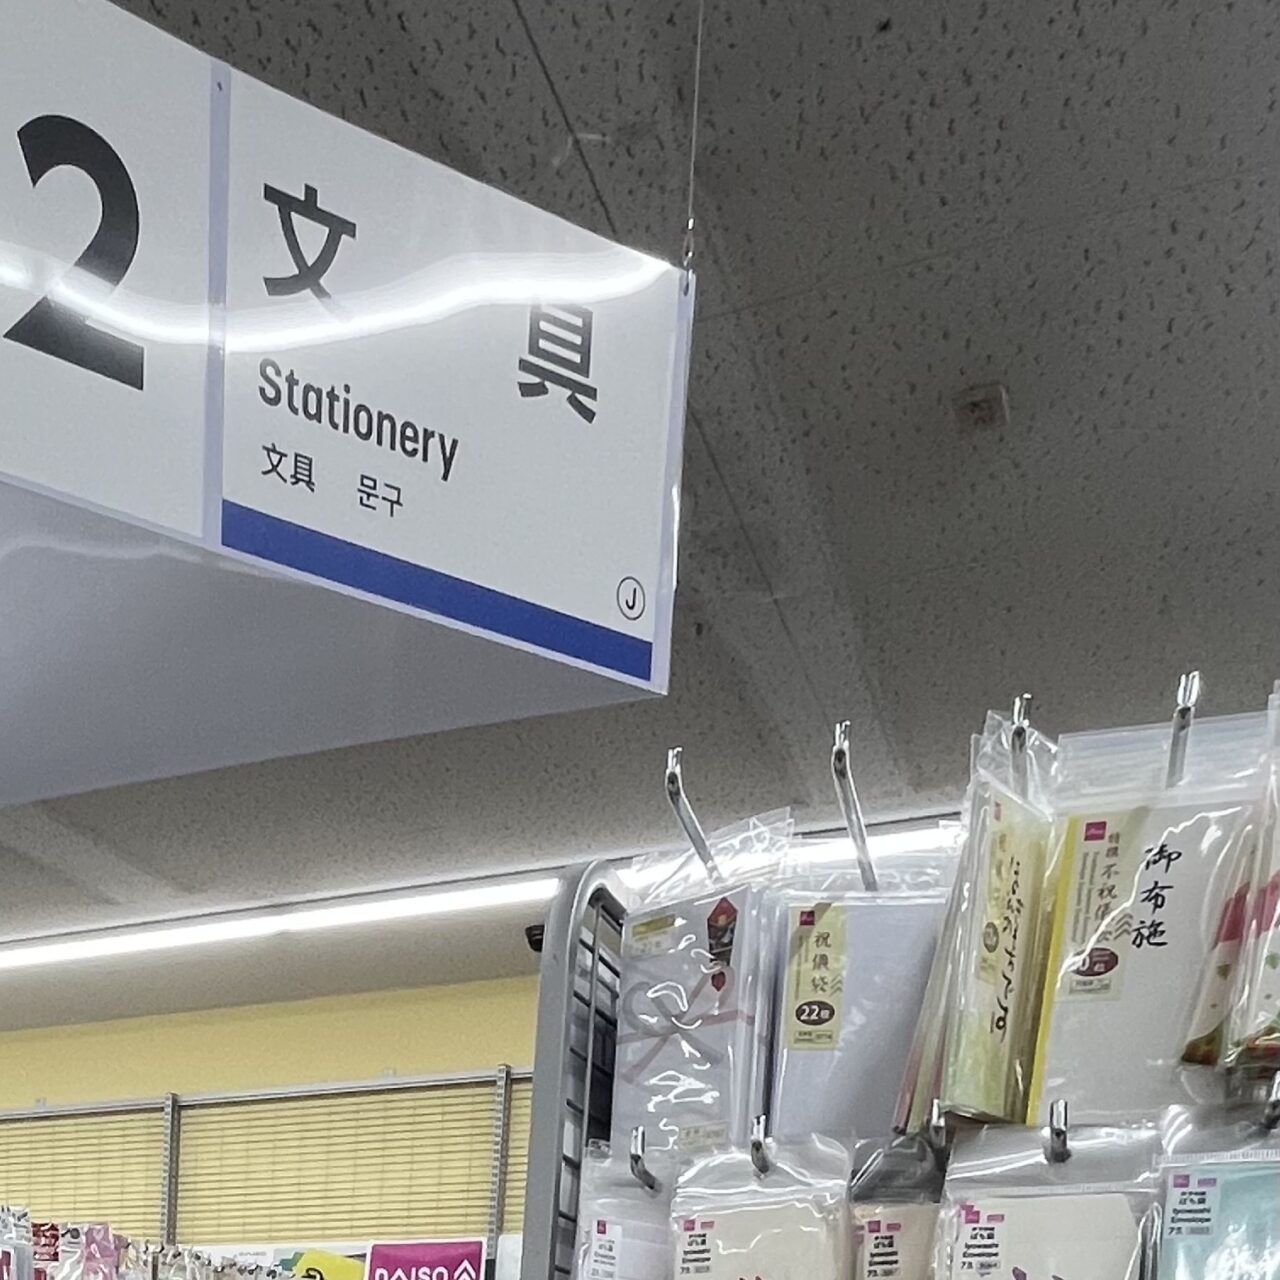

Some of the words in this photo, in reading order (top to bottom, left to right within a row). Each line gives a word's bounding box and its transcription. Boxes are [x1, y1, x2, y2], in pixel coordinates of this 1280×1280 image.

[3, 115, 144, 391] 2
[258, 358, 459, 481] Stationery
[261, 443, 316, 493] 文具
[356, 473, 404, 518] 문구
[1132, 844, 1182, 948] 御布施
